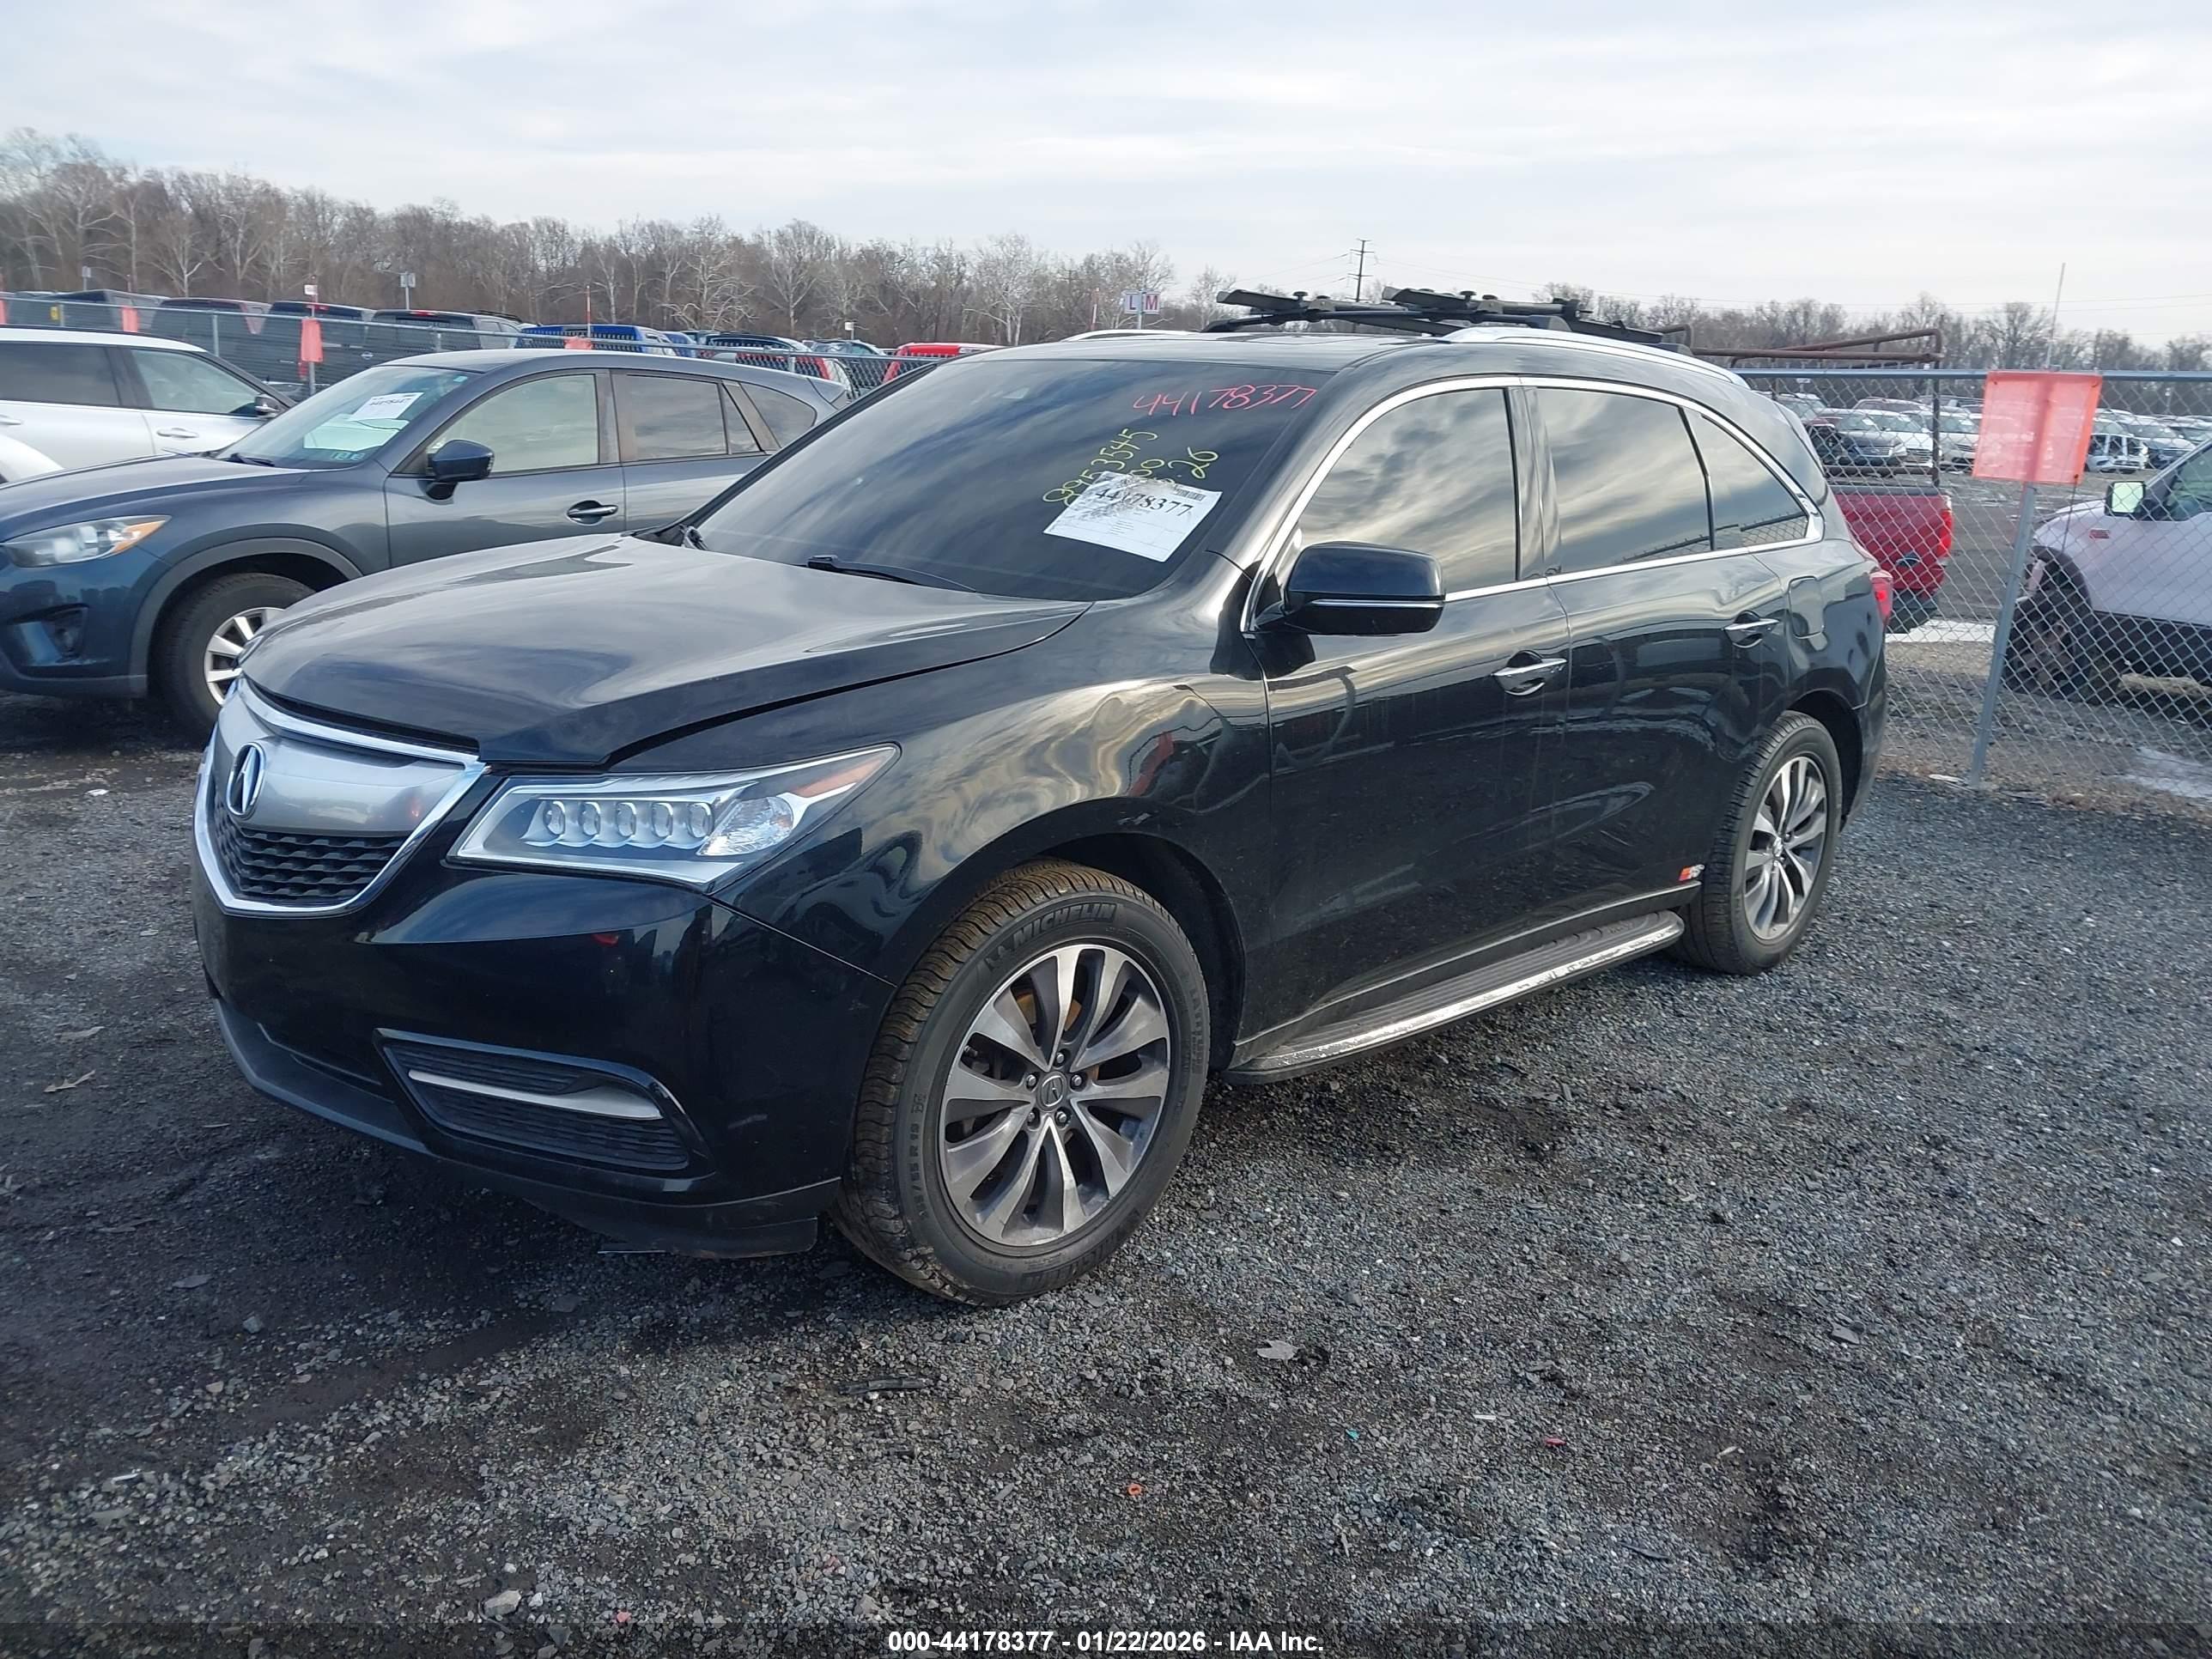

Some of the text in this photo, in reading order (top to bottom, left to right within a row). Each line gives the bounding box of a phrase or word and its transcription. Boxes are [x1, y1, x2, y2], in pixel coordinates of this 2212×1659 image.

[1129, 295, 1136, 310] L
[1146, 295, 1158, 310] M
[1133, 384, 1318, 416] 44178377
[1012, 902, 1116, 946] MICHELIN
